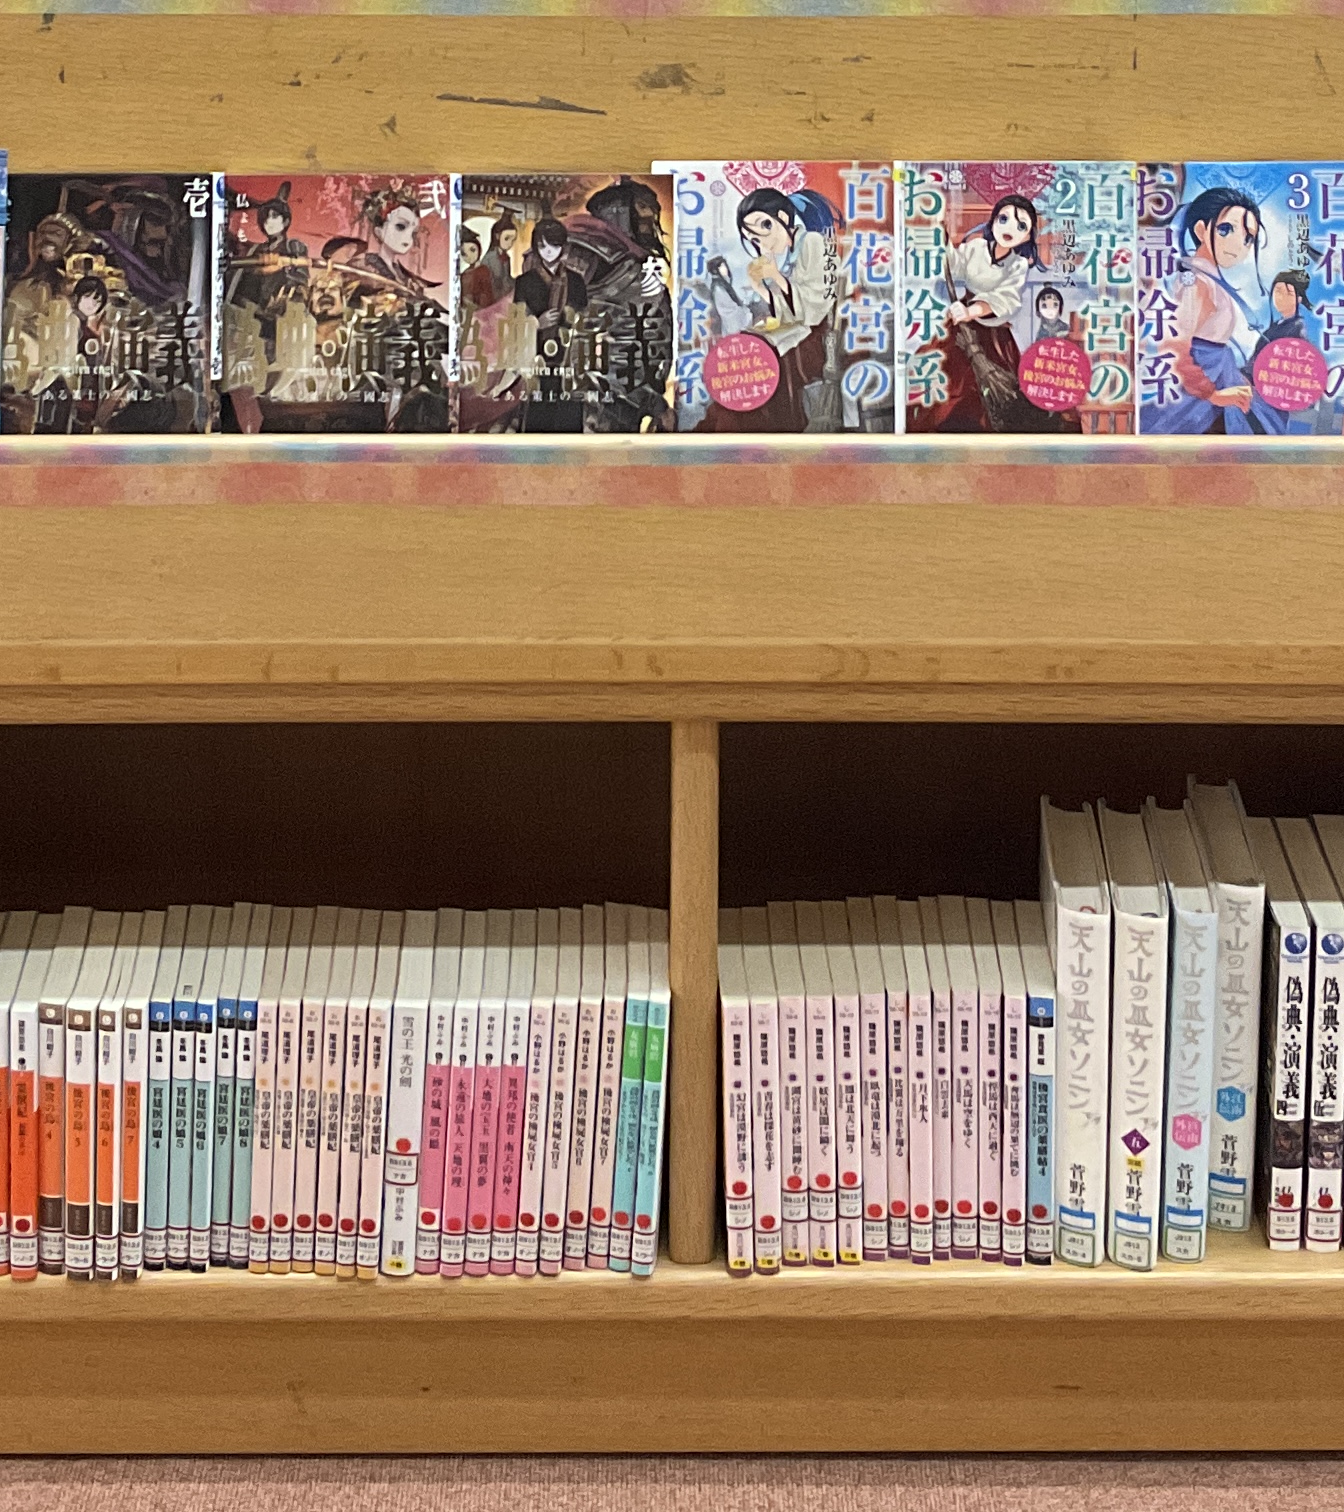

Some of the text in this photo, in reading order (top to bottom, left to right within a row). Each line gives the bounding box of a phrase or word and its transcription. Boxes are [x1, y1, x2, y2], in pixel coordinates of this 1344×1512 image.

[183, 178, 210, 219] 壱
[1056, 179, 1077, 214] 2
[1287, 174, 1309, 208] 3
[641, 254, 668, 296] 参
[841, 169, 893, 402] 百花宮の
[1081, 170, 1133, 404] 百花宮の
